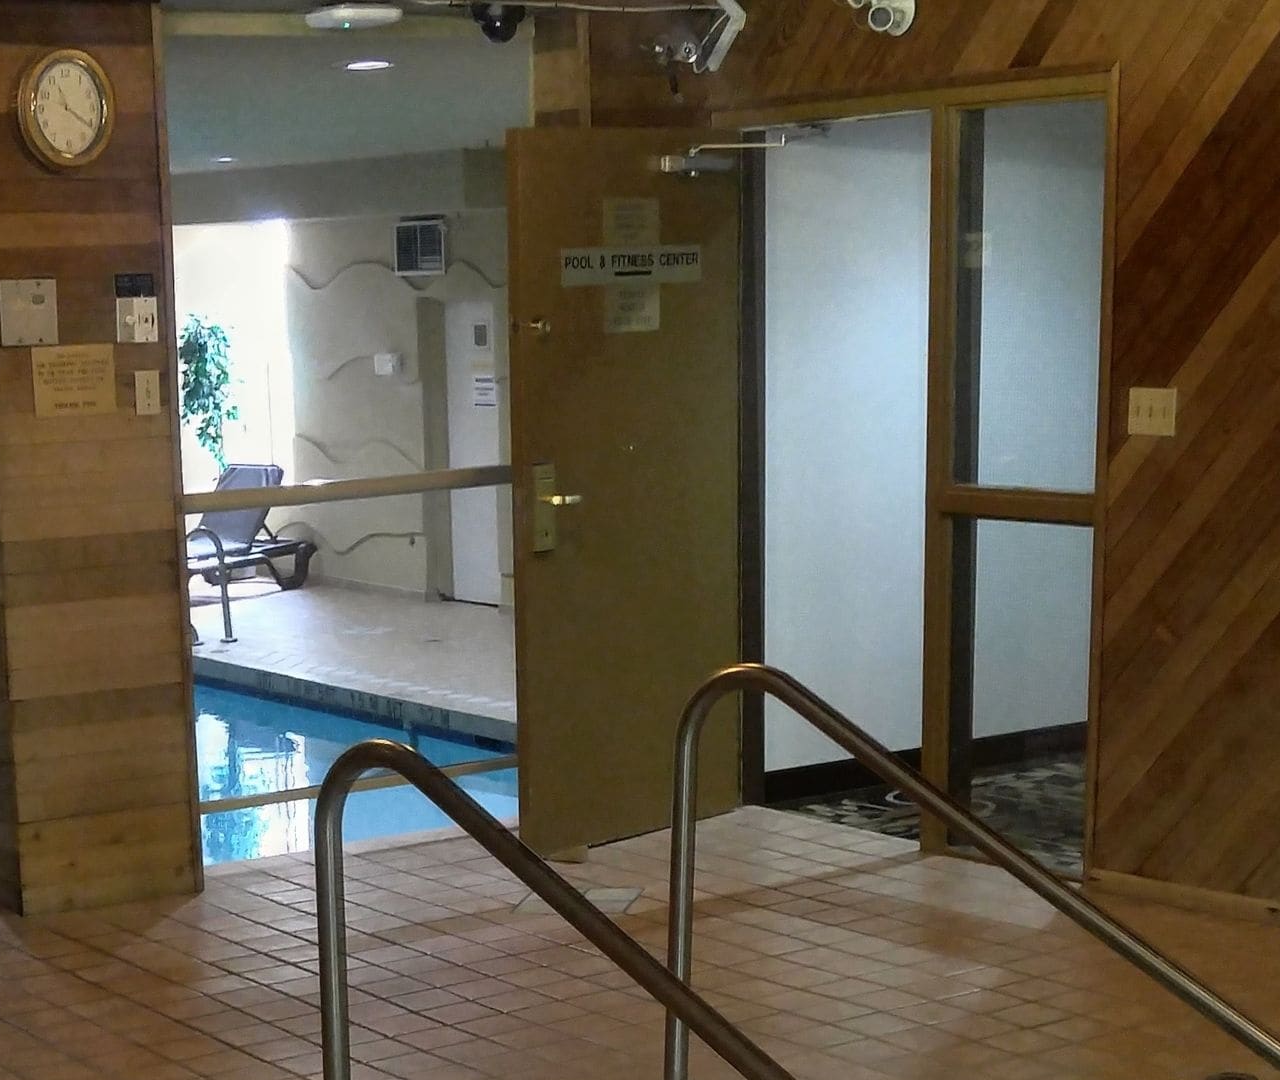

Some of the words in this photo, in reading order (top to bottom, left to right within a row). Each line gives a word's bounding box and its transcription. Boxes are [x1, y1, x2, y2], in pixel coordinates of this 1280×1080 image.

[564, 255, 593, 270] POOL
[611, 253, 654, 268] FITNESS
[659, 251, 698, 266] CENTER
